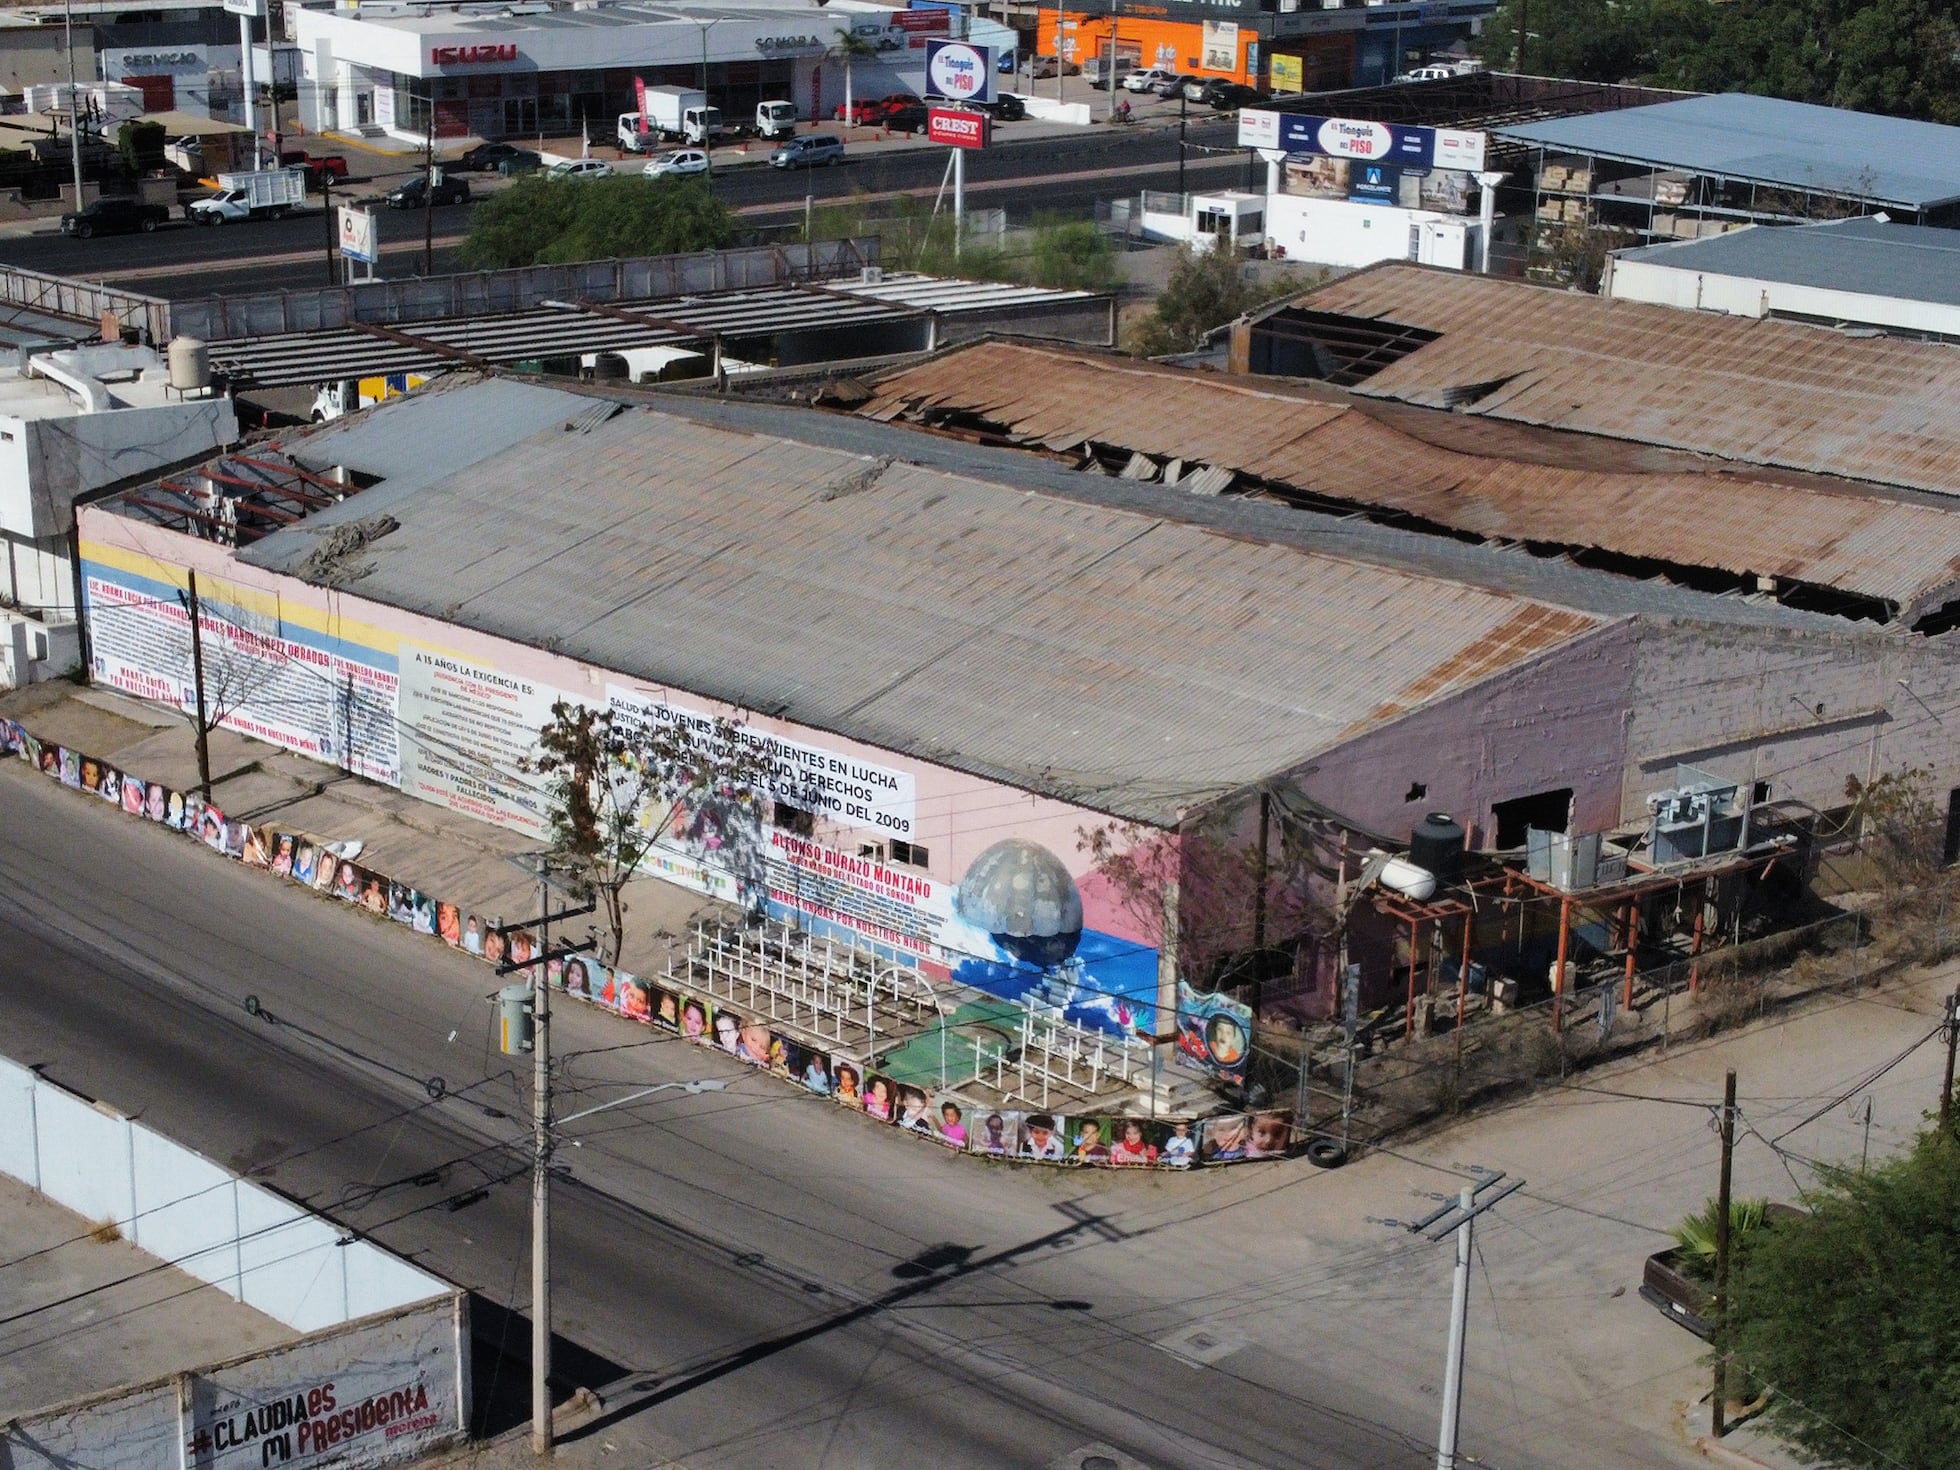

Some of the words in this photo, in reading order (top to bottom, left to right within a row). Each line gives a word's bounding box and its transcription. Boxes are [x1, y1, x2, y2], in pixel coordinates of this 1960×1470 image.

[432, 44, 517, 65] ISUZU
[754, 34, 821, 50] SONORA
[122, 52, 197, 67] SERVICIO
[954, 74, 974, 91] PISO
[932, 116, 979, 135] CREST
[1339, 123, 1373, 137] Tianguis
[1349, 139, 1373, 154] PISO
[226, 624, 258, 644] MANUEL
[415, 652, 421, 662] A
[424, 655, 431, 664] 15
[434, 656, 457, 672] AÑOS
[460, 665, 471, 676] LA
[473, 669, 518, 691] EXIGENCIA
[521, 684, 534, 696] ES:
[610, 697, 638, 713] SALUD
[233, 717, 254, 731] UNIDAS
[255, 724, 266, 736] POR
[267, 728, 298, 746] NUESTROS
[654, 706, 712, 734] JOVENES
[828, 759, 849, 776] EN
[851, 765, 898, 791] LUCHA
[704, 740, 734, 759] VIDA
[799, 768, 874, 803] DERECHOS
[768, 777, 777, 791] 5
[779, 781, 799, 799] DE
[800, 787, 843, 813] JUNIO
[845, 801, 872, 821] DEL
[874, 810, 909, 833] 2009
[772, 830, 821, 862] ALFONSO
[824, 848, 868, 878] DURAZO
[873, 863, 931, 899] MONTAÑO
[786, 850, 831, 877] GOBERNADOR
[846, 872, 873, 891] ESTADO
[885, 886, 914, 905] SONORA
[771, 887, 799, 908] MANOS
[835, 911, 852, 927] POR
[856, 917, 900, 945] NUESTROS
[262, 1432, 291, 1468] MI
